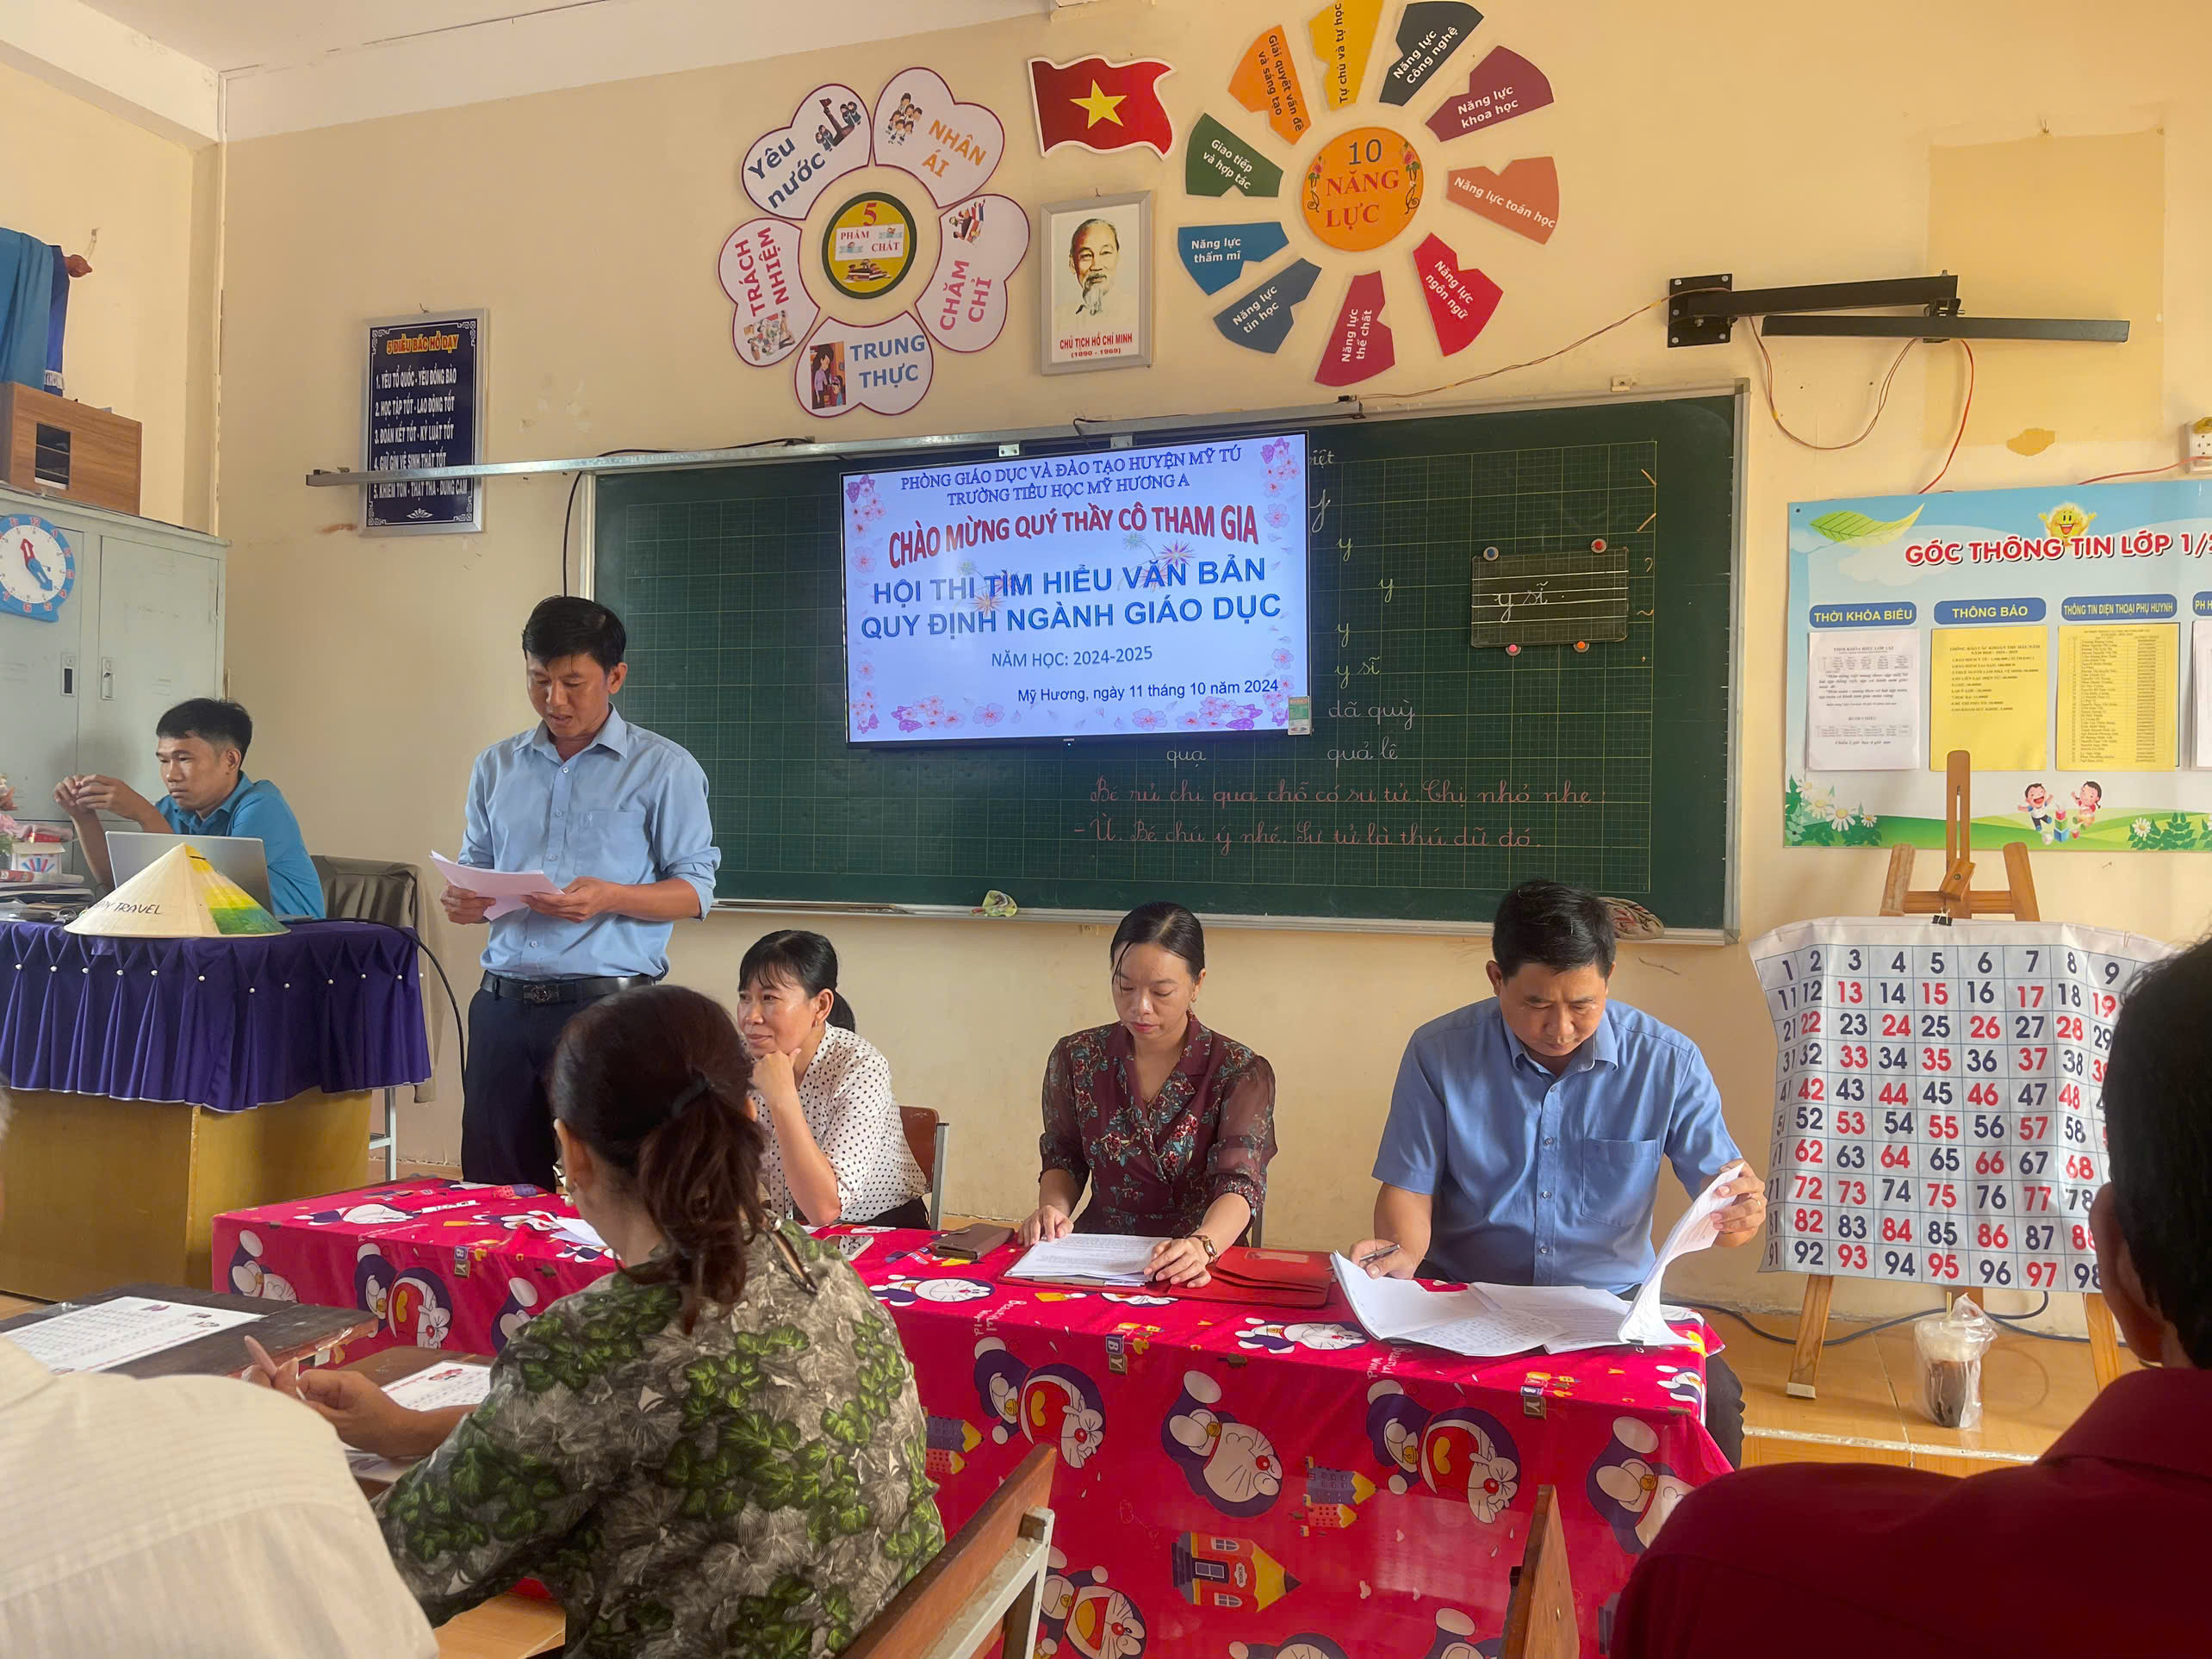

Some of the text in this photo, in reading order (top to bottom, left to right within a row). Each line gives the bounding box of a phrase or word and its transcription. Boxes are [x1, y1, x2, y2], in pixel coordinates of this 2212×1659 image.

[1334, 3, 1349, 104] Tự chủ và tự học
[1392, 29, 1438, 79] Năng lực
[1406, 26, 1458, 84] Công nghệ
[1258, 51, 1283, 116] và sáng tạo
[1268, 34, 1305, 132] Giải quyết vấn đề
[1457, 85, 1514, 115] Năng lực
[1461, 99, 1519, 129] khoa học
[921, 118, 987, 178] NHÂN ÁI
[1211, 139, 1253, 173] Giao tiếp
[1349, 139, 1382, 165] 10
[748, 138, 826, 208] Yêu nước
[1202, 151, 1252, 190] và hợp tác
[1326, 169, 1400, 196] NĂNG
[862, 202, 877, 227] 5
[1325, 202, 1379, 231] LỰC
[1454, 177, 1556, 228] Năng lực toán học
[1191, 237, 1241, 250] Năng lực
[1194, 251, 1241, 264] thẩm mĩ
[735, 239, 766, 317] TRÁCH
[757, 227, 790, 306] NHIỆM
[1434, 260, 1474, 305] Năng lực
[940, 259, 970, 331] CHĂM
[967, 276, 992, 323] CHỈ
[1233, 286, 1277, 326] Năng lực
[1425, 274, 1469, 320] ngôn ngữ
[1243, 302, 1279, 333] tin học
[1356, 309, 1372, 360] thể chất
[849, 334, 925, 362] TRUNG
[1059, 332, 1133, 351] CHỦ TỊCH HỒ CHÍ MINH
[1341, 308, 1359, 363] Năng lực
[858, 363, 918, 388] THỰC
[901, 444, 1241, 490] PHÒNG GIÁO DỤC VÀ ĐÀO TẠO HUYỆN MỸ TÚ
[948, 488, 1010, 506] TRƯỜNG
[1051, 482, 1084, 499] HỌC
[1087, 477, 1112, 494] MỸ
[1116, 475, 1175, 492] HƯƠNG
[1177, 473, 1190, 487] A
[889, 501, 1258, 569] CHÀO MỪNG QUÝ THẦY CÔ THAM GIA
[1904, 539, 1962, 564] GÓC
[1969, 535, 2064, 562] THÔNG
[2071, 536, 2115, 557] TIN
[2121, 530, 2172, 555] LỚP
[873, 554, 1264, 608] HỘI THI TÌM HIỂU VĂN BẢN
[861, 593, 1281, 640] QUY ĐỊNH NGÀNH GIÁO DỤC
[1814, 611, 1842, 623] THỜI
[1846, 610, 1881, 622] KHÓA
[1952, 605, 2029, 619] THÔNG BÁO
[2064, 602, 2173, 616] THÔNG TIN ĐIỆN THOẠI PHỤ HUYNH
[2195, 600, 2205, 610] PH
[991, 646, 1153, 668] NĂM HỌC: 2024-2025
[1018, 679, 1278, 704] Mỹ Hương, ngày 11 tháng 10 năm 2024
[114, 902, 164, 915] TRAVEL
[1782, 949, 2119, 984] 1 2 3 4 5 6 7 8 9
